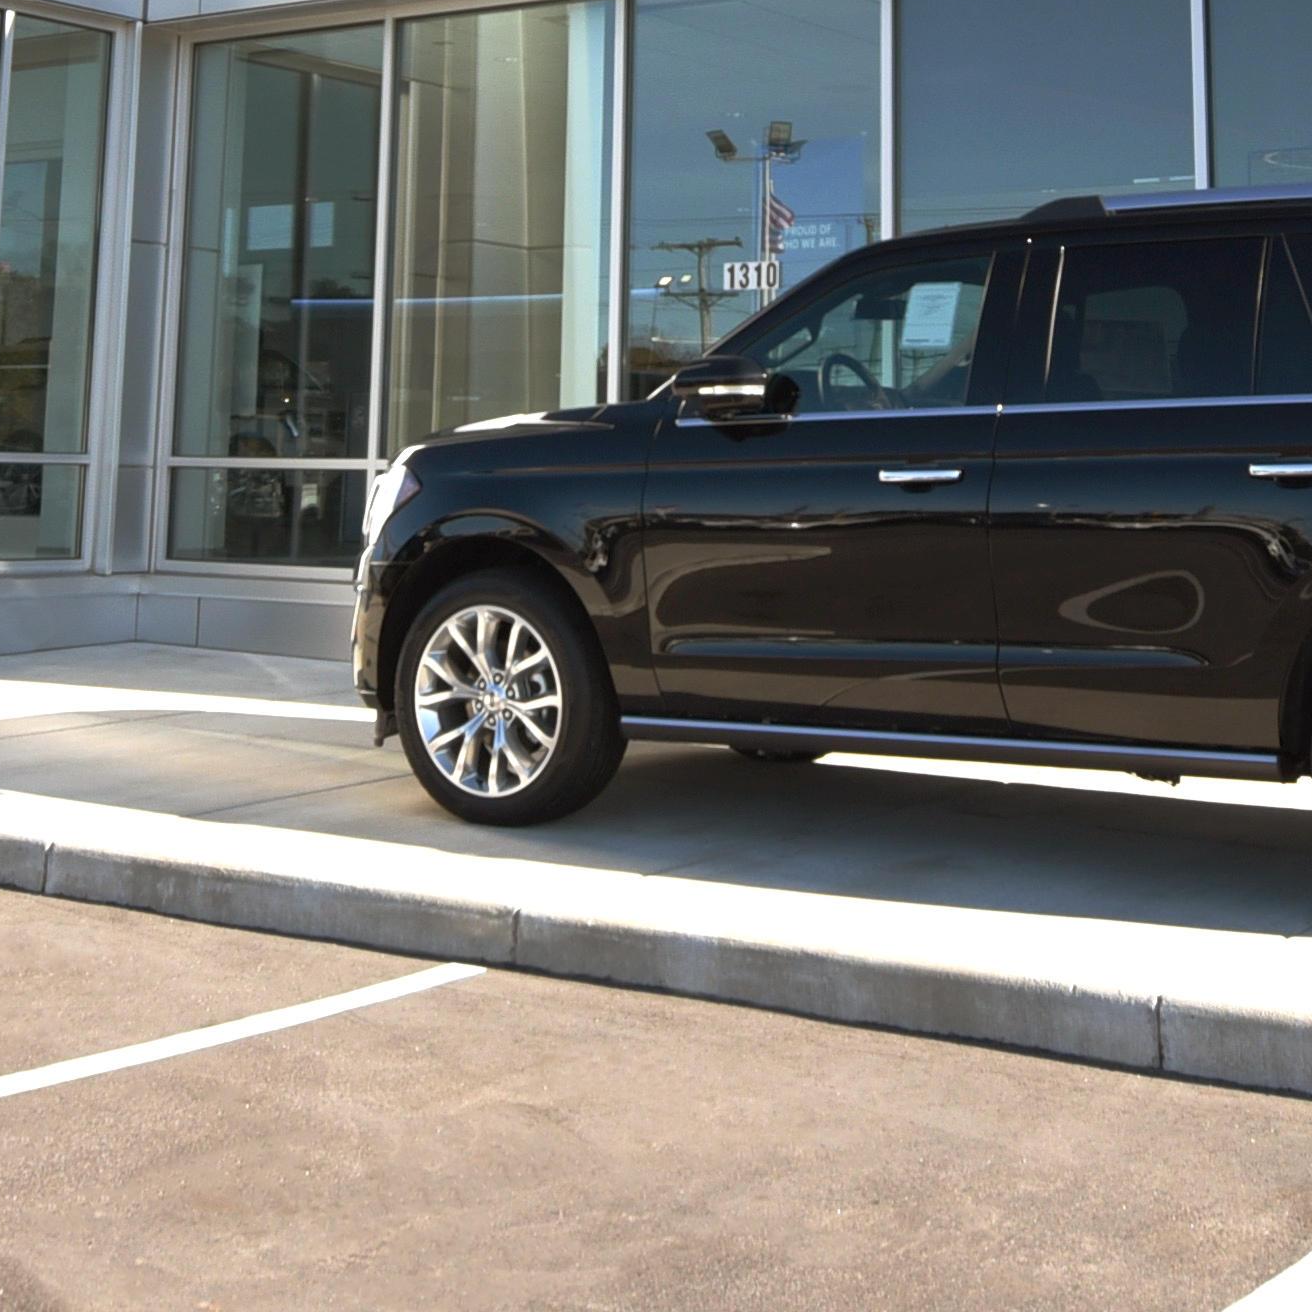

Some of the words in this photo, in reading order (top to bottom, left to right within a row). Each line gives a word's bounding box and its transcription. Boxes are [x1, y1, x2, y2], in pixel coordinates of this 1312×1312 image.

[819, 223, 832, 236] OF
[801, 238, 815, 249] WE
[727, 262, 777, 289] 1310
